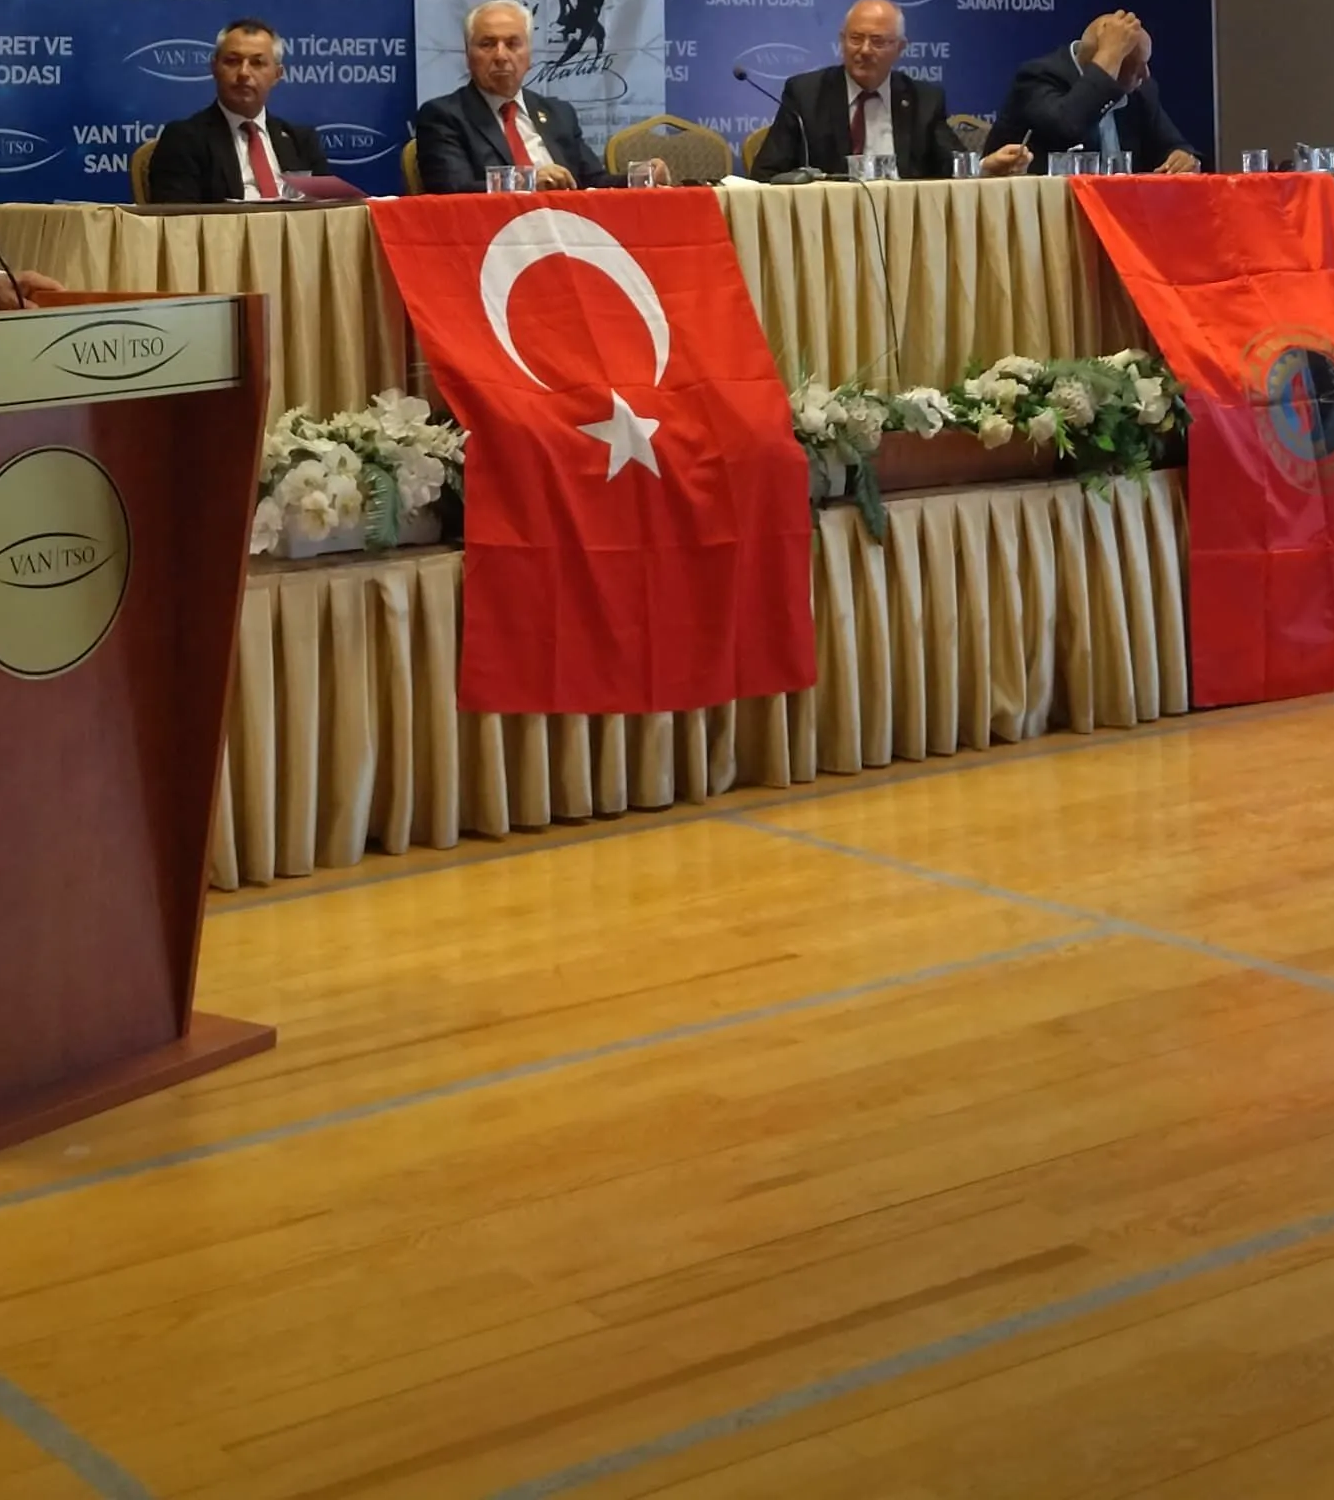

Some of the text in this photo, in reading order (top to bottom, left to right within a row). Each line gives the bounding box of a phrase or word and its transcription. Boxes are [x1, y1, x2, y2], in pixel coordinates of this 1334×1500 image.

[44, 37, 73, 56] VE
[297, 33, 379, 56] TİCARET
[381, 38, 406, 56] VE
[675, 40, 698, 57] VE
[930, 42, 951, 58] VE
[153, 49, 186, 65] VAN
[279, 60, 397, 84] ANAYİ ODASI
[665, 65, 689, 82] ASI
[73, 124, 118, 145] VAN
[350, 134, 374, 148] TSO
[6, 140, 34, 155] TSO
[72, 336, 165, 365] VAN TSO
[9, 545, 96, 577] VAN TSO
